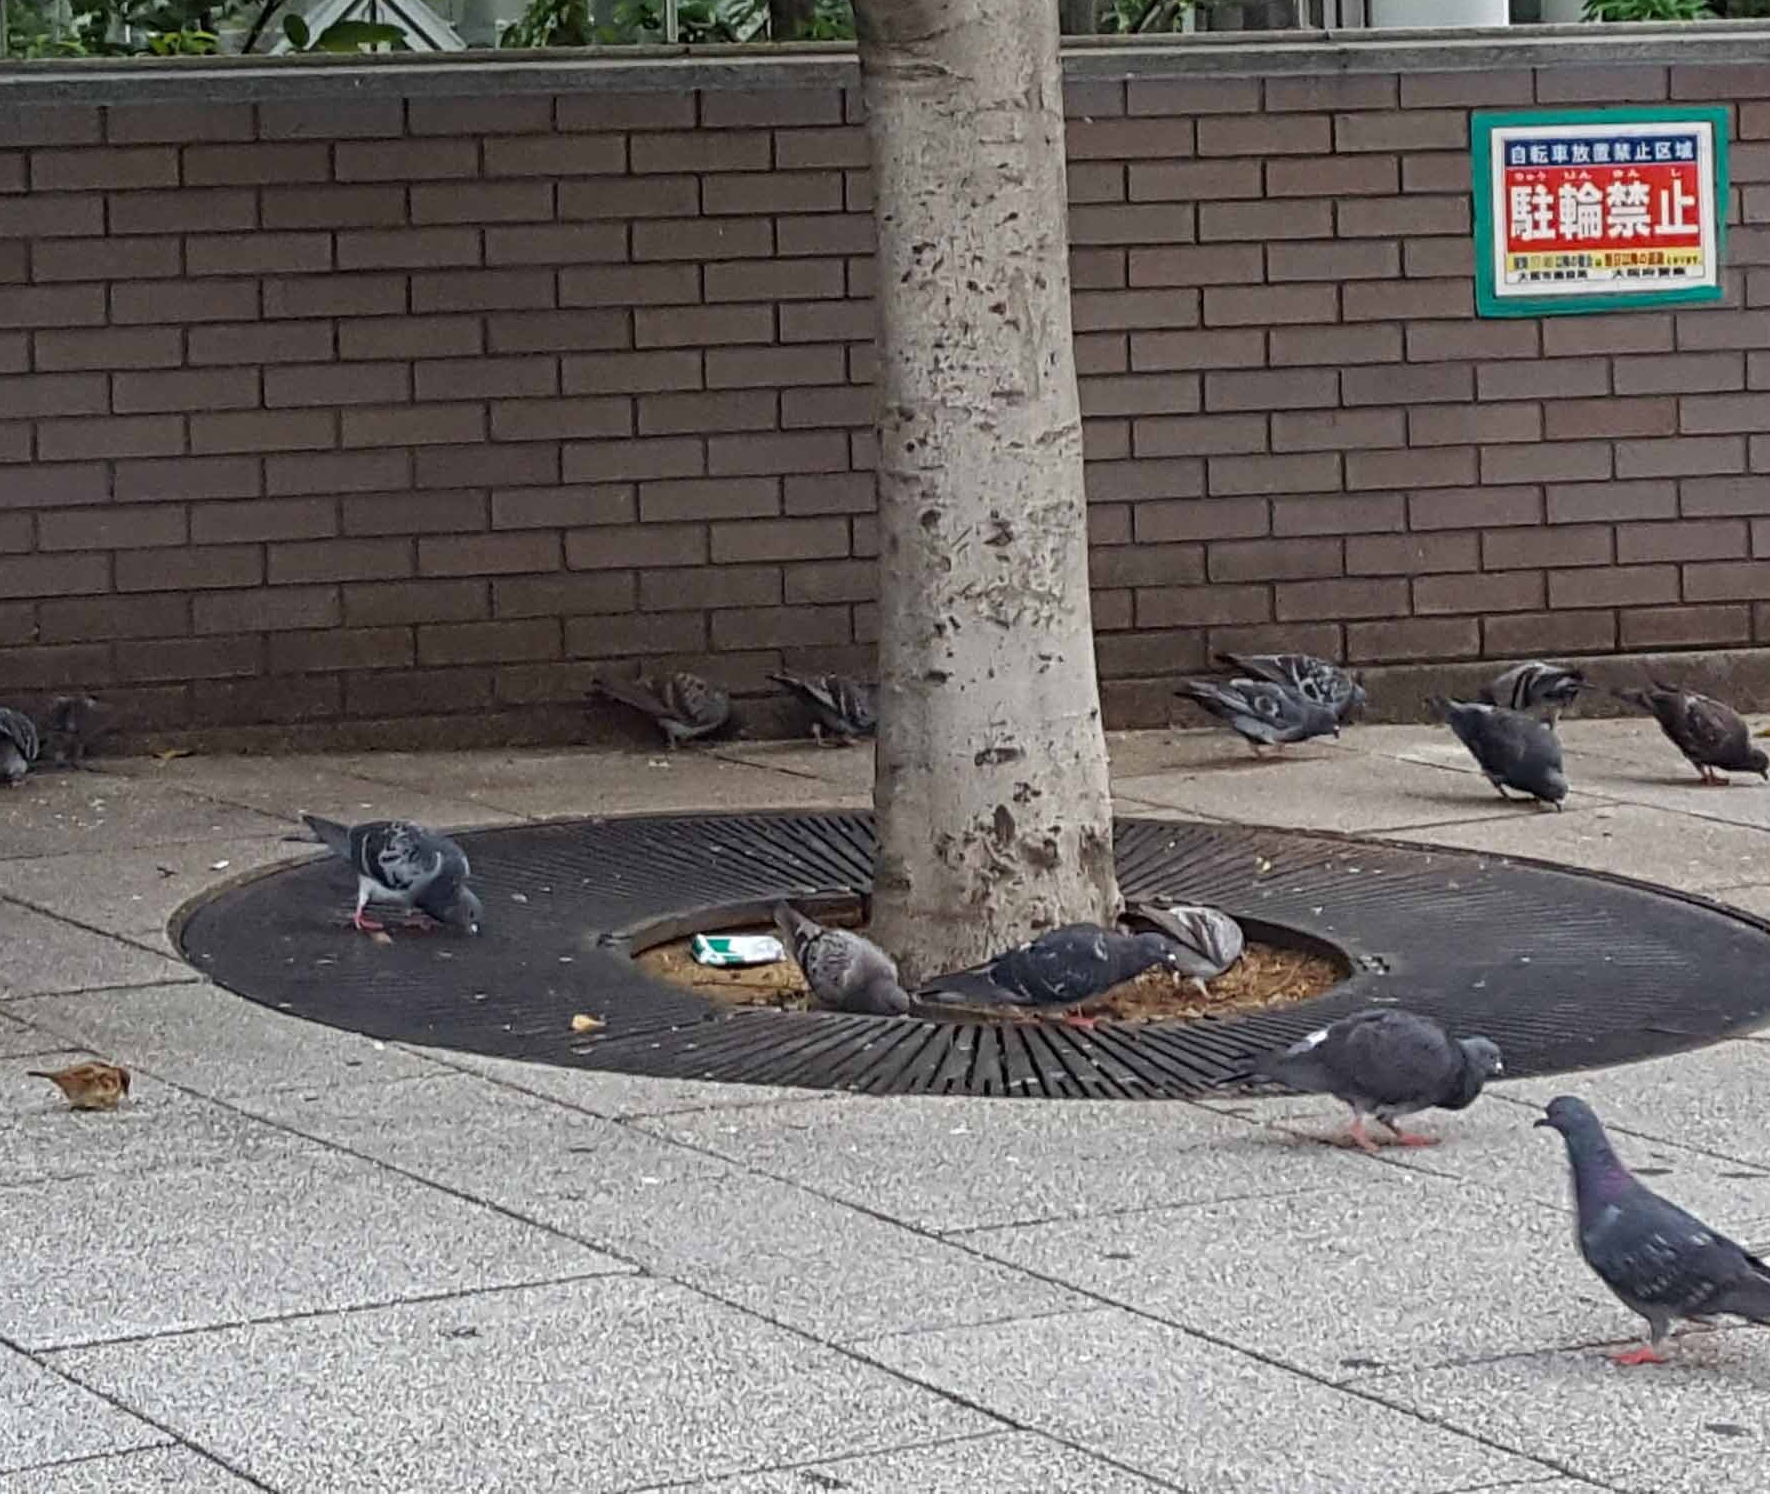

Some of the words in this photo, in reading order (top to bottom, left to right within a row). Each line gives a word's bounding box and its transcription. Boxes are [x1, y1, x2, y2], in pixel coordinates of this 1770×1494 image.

[1511, 141, 1694, 164] 自転車放置禁止区域
[1510, 179, 1699, 241] 駐輪禁止
